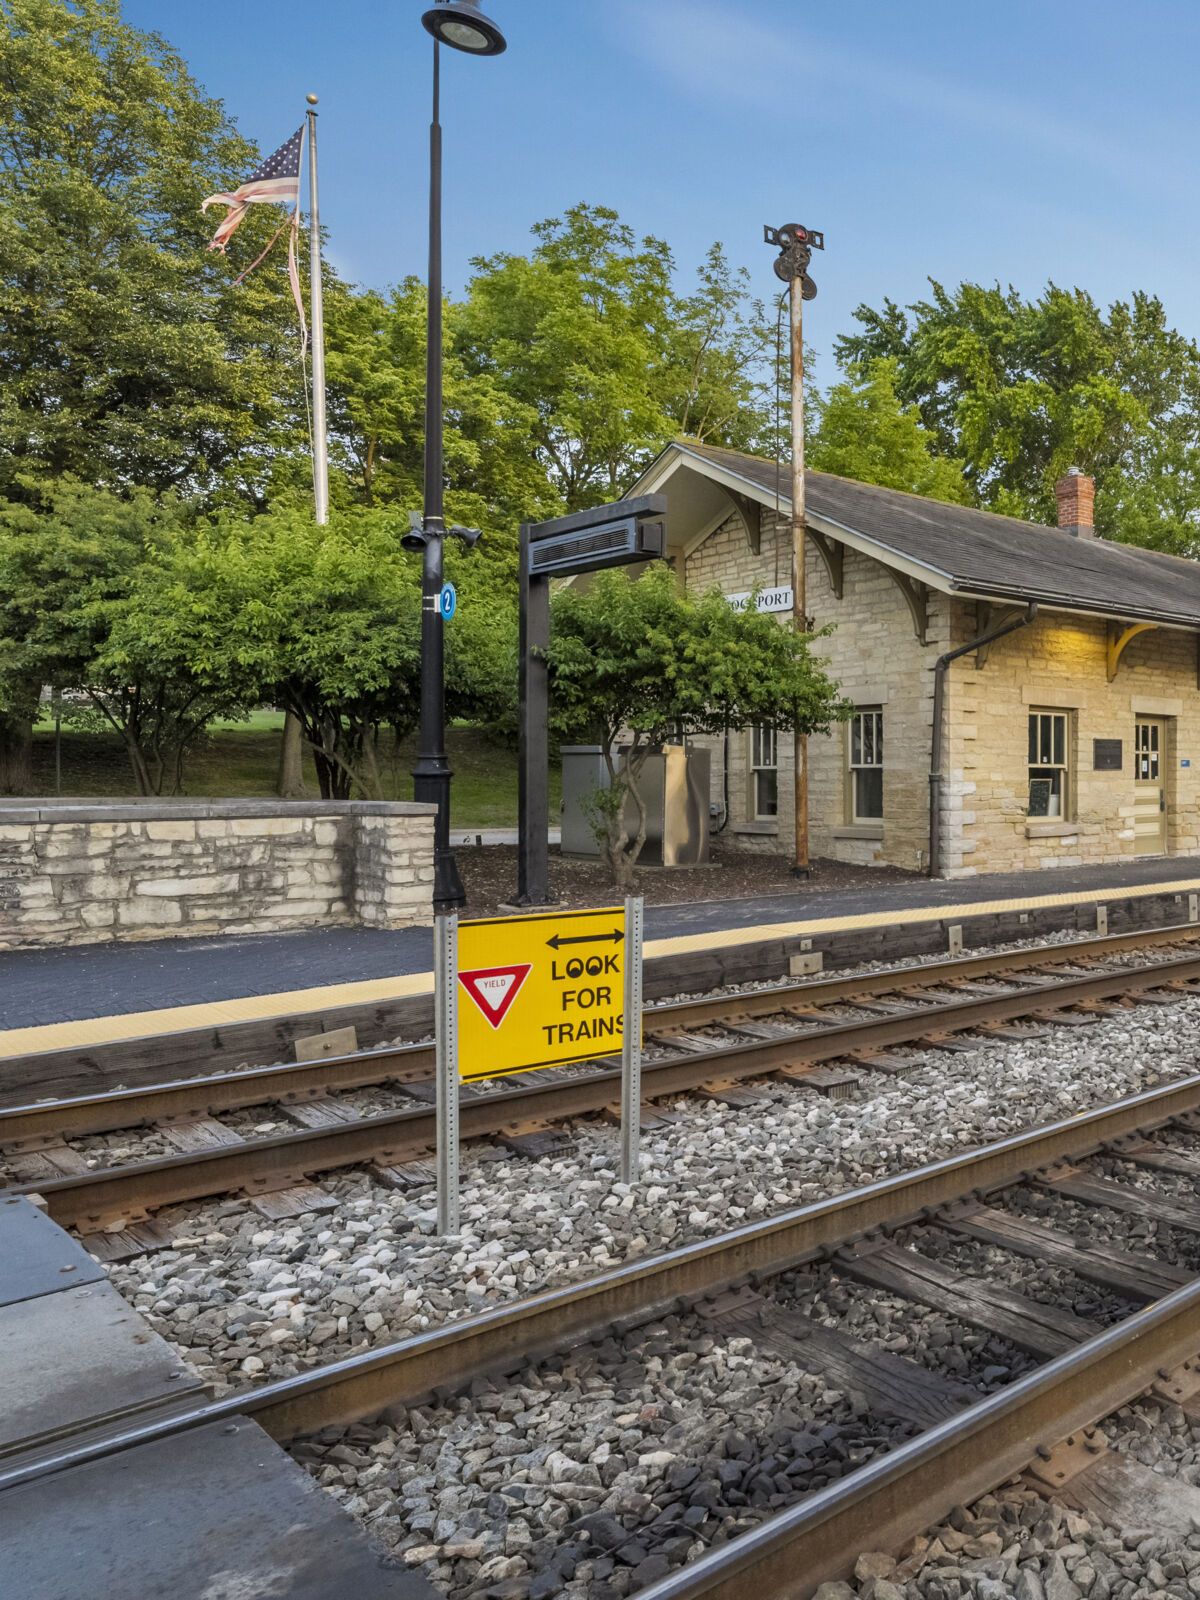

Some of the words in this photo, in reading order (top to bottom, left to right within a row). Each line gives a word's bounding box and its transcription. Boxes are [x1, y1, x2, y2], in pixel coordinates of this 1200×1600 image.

[444, 592, 451, 611] 2
[730, 591, 791, 611] OCPORT
[551, 953, 620, 981] LOOK
[483, 978, 506, 989] YIELD
[562, 986, 611, 1011] FOR
